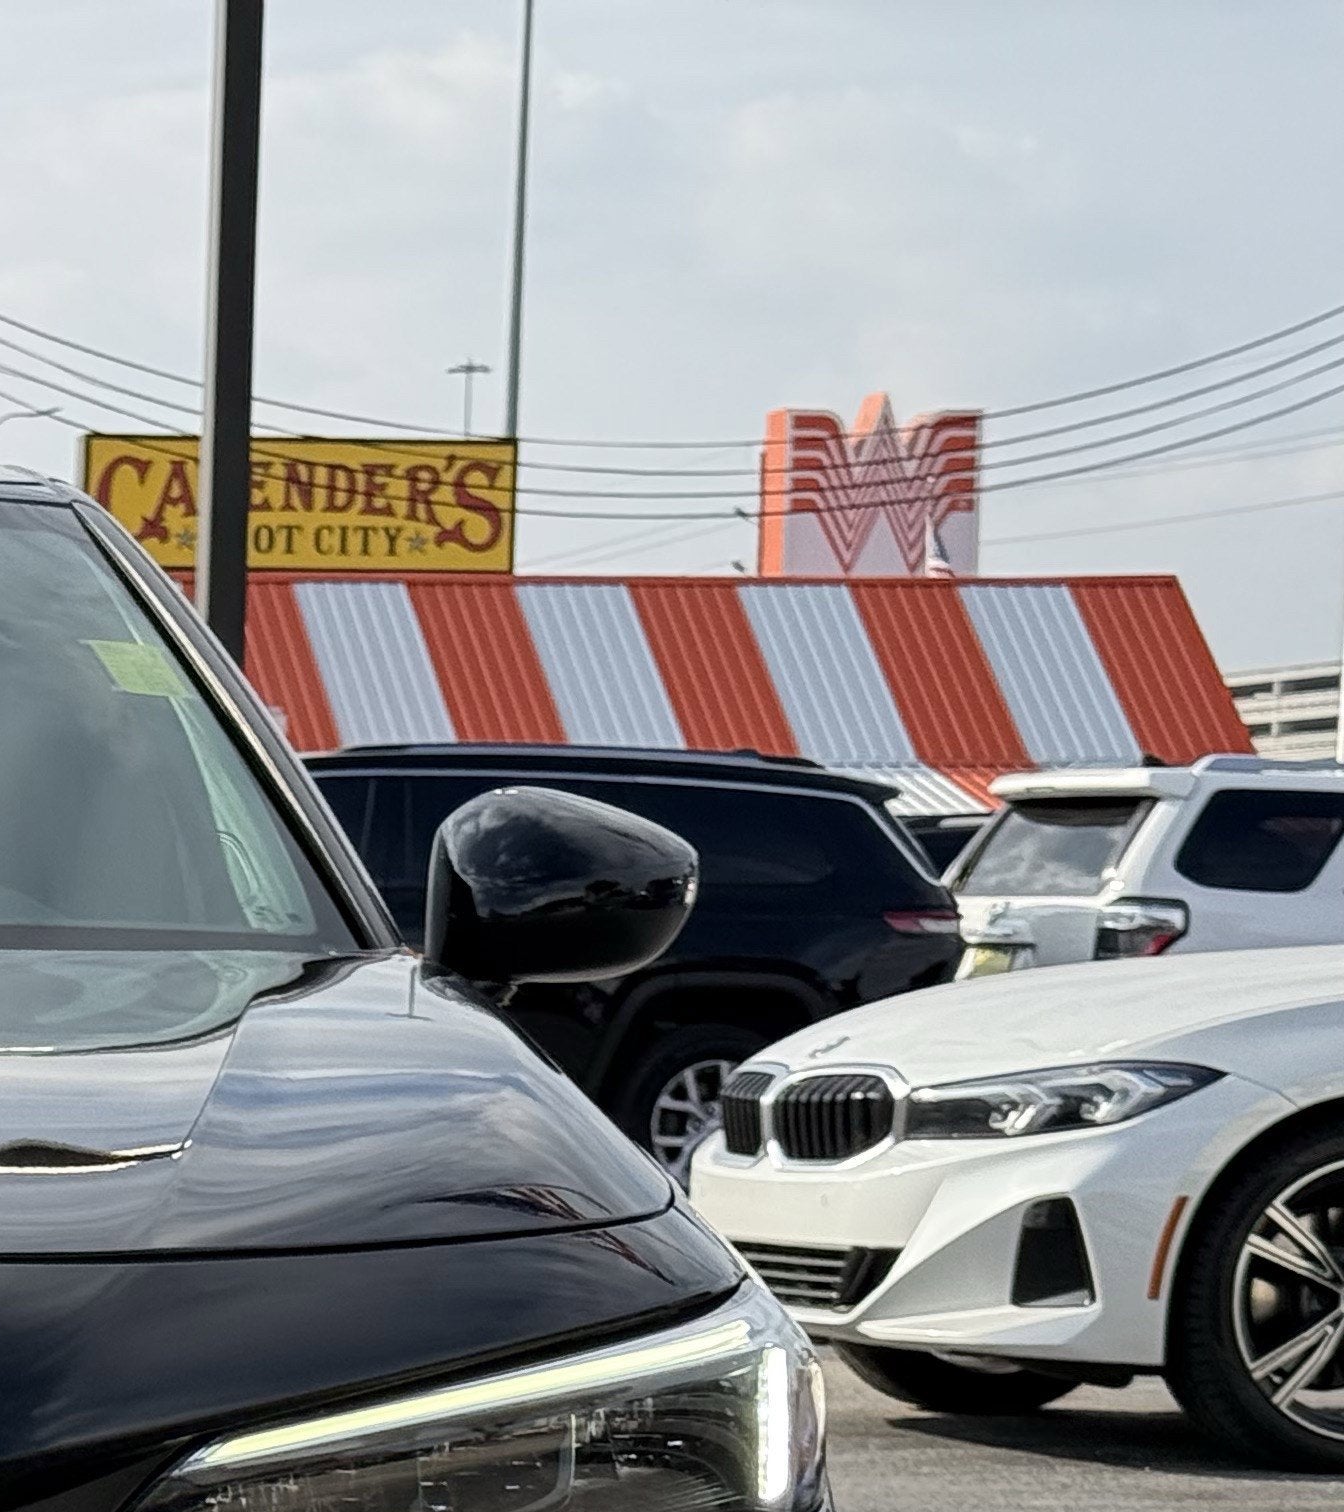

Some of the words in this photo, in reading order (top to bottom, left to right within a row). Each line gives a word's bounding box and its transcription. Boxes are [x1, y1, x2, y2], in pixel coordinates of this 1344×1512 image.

[95, 453, 503, 553] CAENDER'S
[253, 524, 305, 555] OT
[313, 524, 403, 557] CITY
